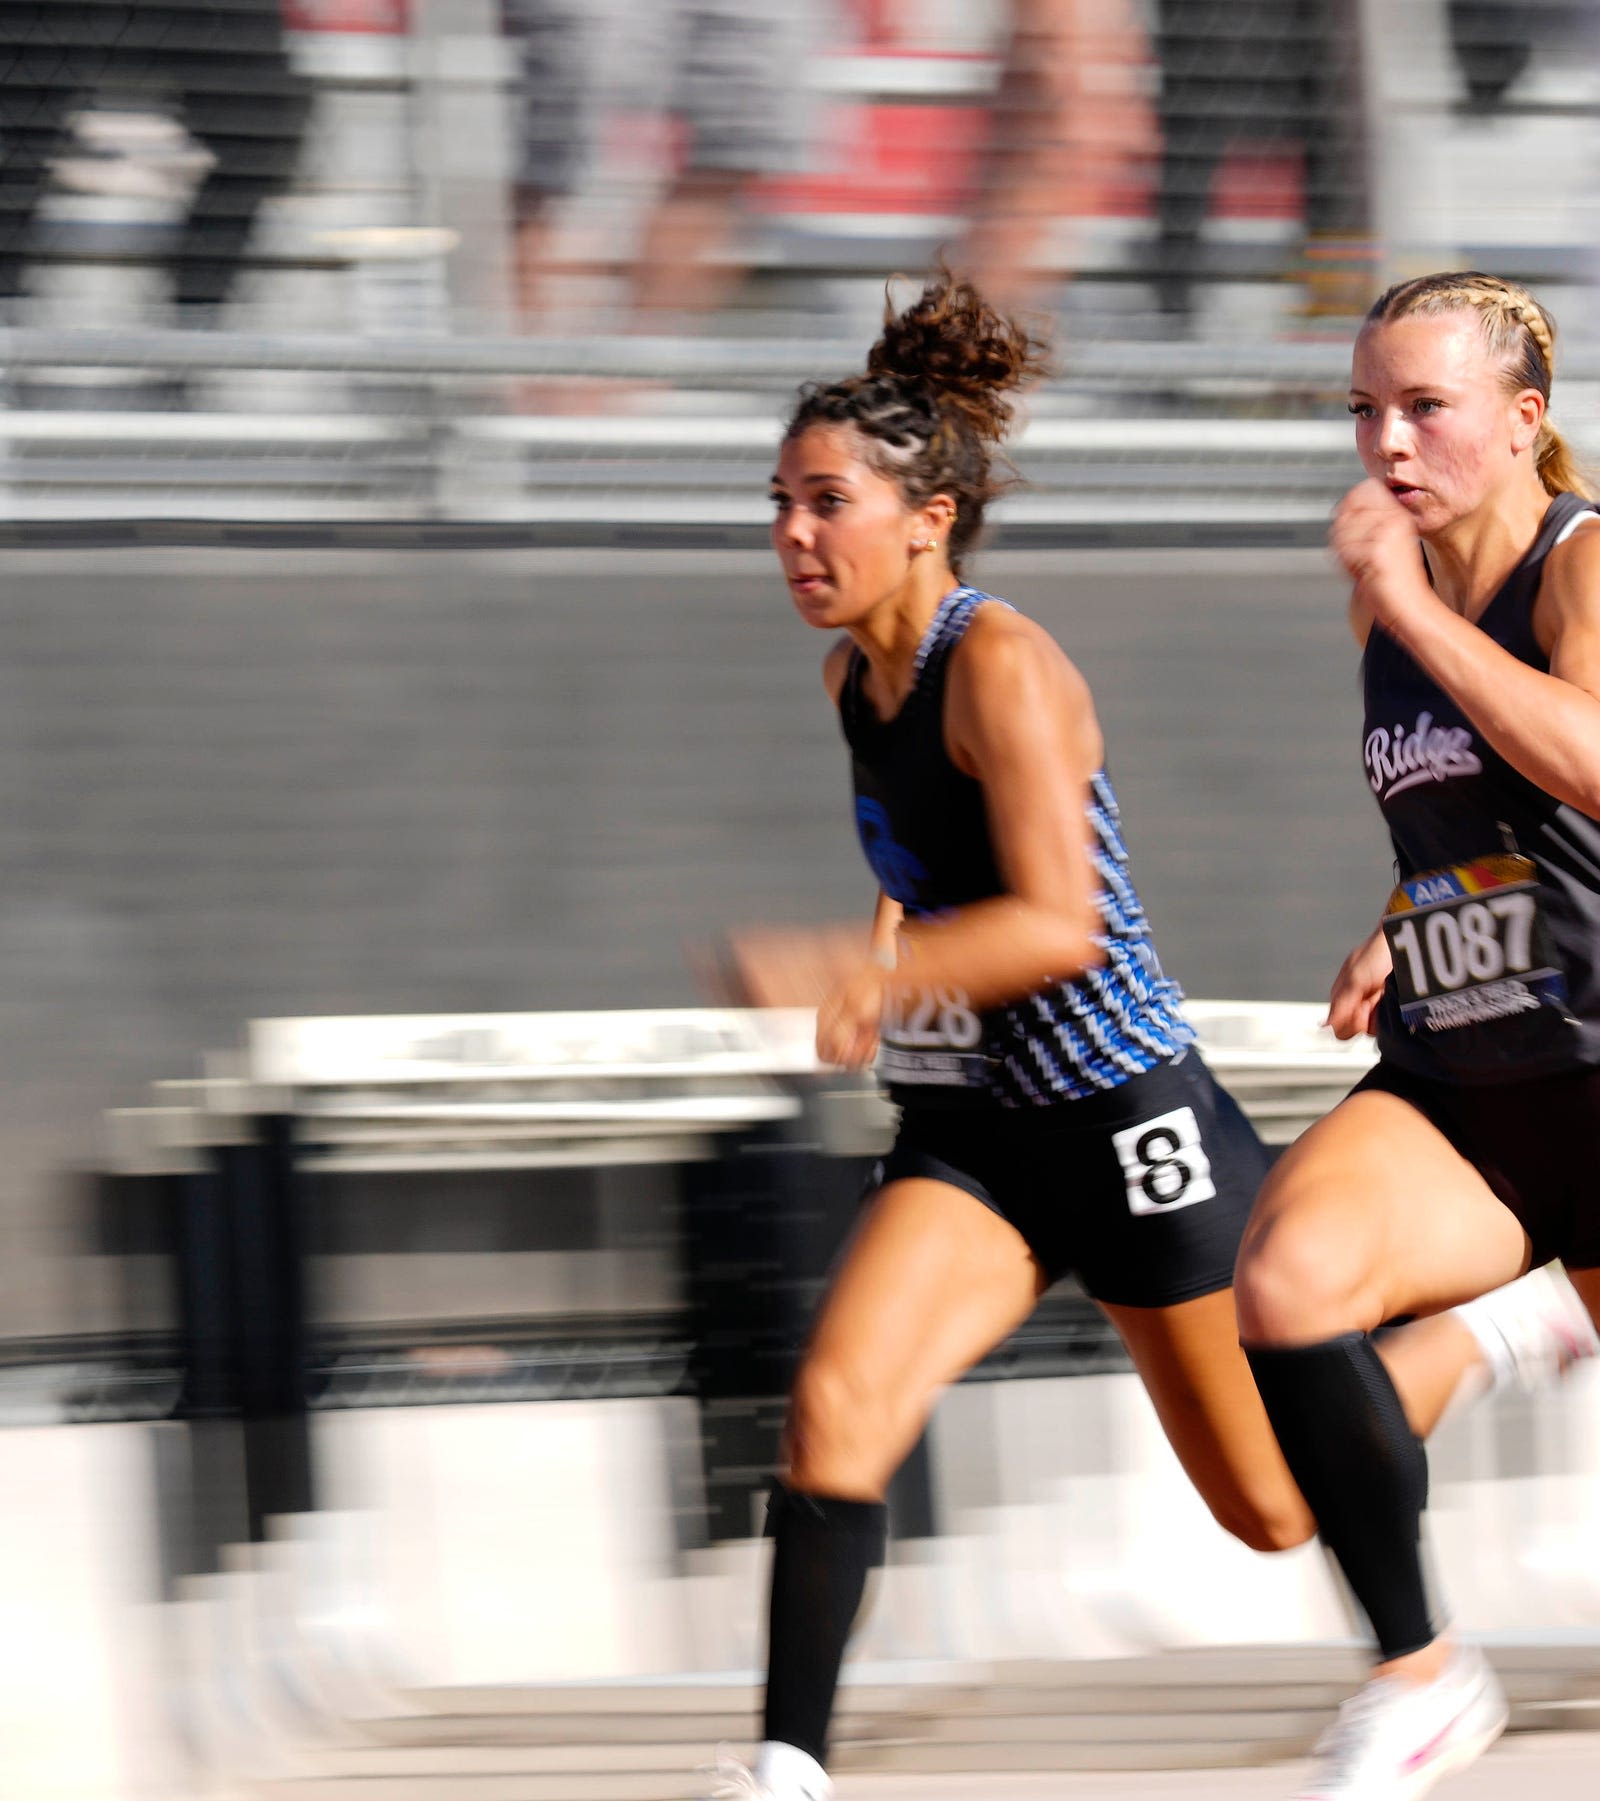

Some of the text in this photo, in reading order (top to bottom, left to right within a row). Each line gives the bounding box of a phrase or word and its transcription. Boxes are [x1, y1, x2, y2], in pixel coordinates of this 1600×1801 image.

[1413, 877, 1457, 906] AIA
[1393, 891, 1536, 998] 1087
[1135, 1126, 1191, 1205] 8
